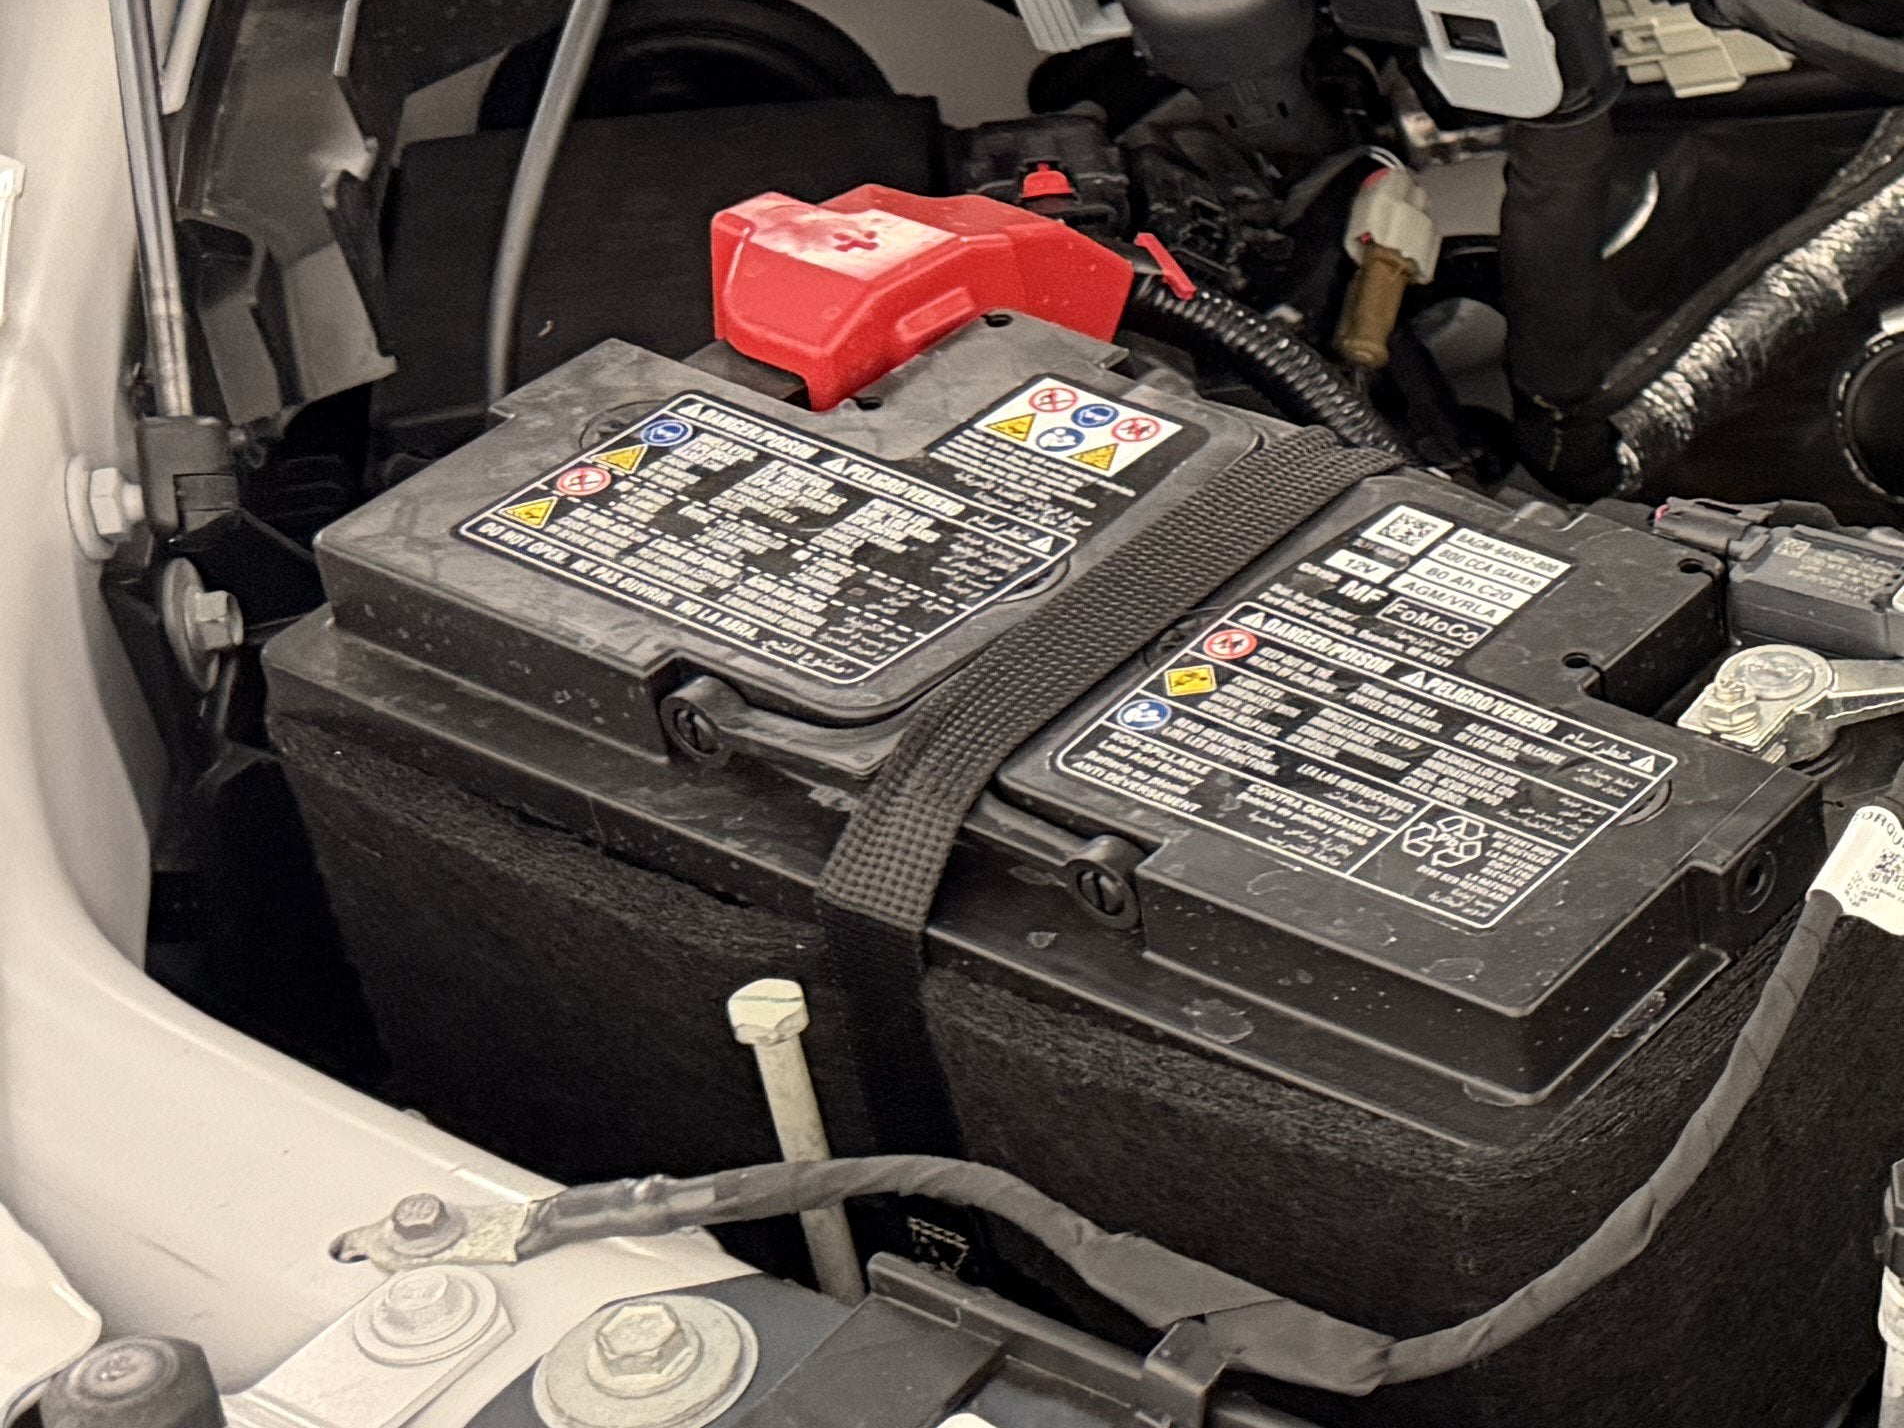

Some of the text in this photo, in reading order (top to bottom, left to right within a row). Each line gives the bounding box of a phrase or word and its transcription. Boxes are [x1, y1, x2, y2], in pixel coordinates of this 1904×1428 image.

[693, 408, 822, 461] DANGER/POISON
[837, 463, 970, 517] PELIGRO/VENENO
[496, 529, 536, 548] NOT
[587, 566, 626, 584] PAS
[1340, 557, 1380, 575] 12V
[1462, 557, 1495, 573] CCA
[1334, 579, 1390, 606] MF
[1398, 578, 1500, 621] AGM/VRLA
[1475, 583, 1515, 602] C20
[693, 608, 725, 623] LA
[1382, 599, 1485, 646] FoMoCo
[1258, 617, 1397, 674] DANGER/POISON
[1420, 676, 1560, 735] PELIGRO/VENENO
[1069, 758, 1109, 778] ANTI
[1244, 782, 1380, 838] CONTRA DERRAMES
